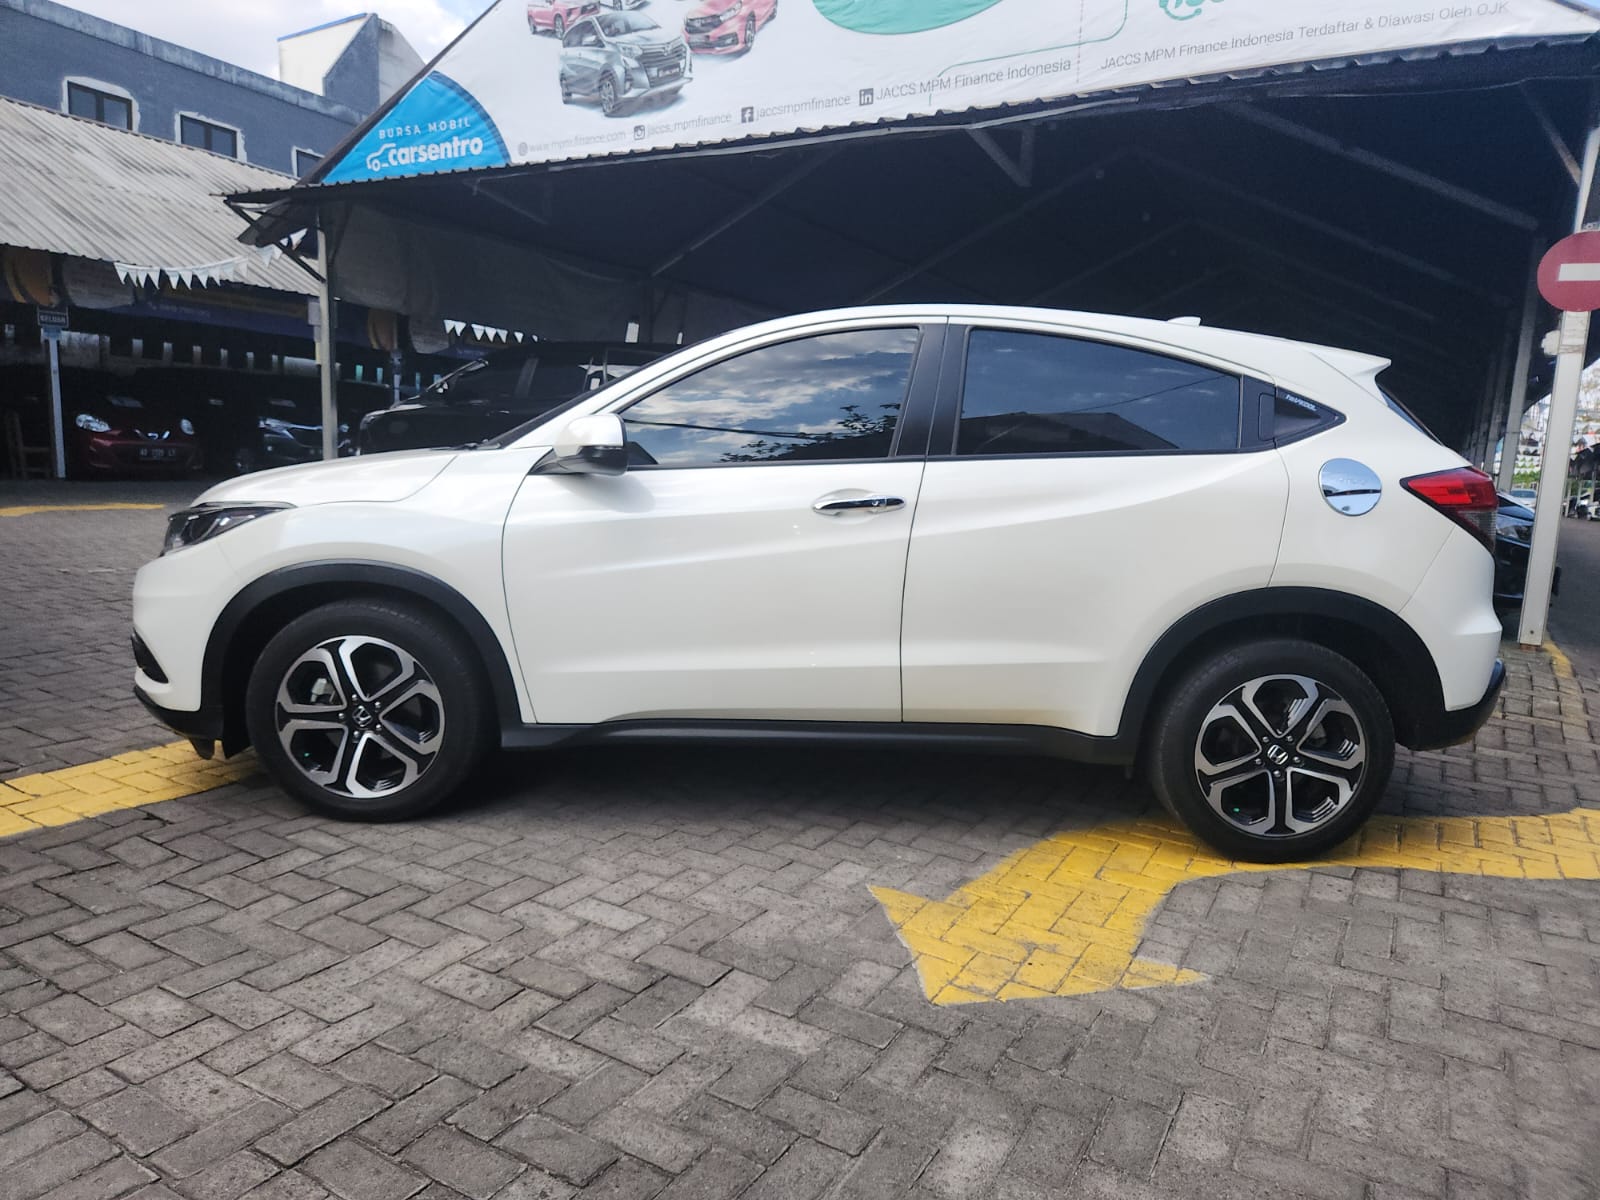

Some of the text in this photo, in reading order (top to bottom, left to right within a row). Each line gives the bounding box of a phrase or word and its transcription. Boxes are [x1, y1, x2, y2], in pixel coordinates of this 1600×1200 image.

[1100, 0, 1510, 70] JACCS MPM Finance Indonesia Terdaftar & Diawasi Oleh OJK
[876, 58, 1071, 100] JACCS MPM Finance Indonesia
[379, 117, 471, 139] BURSA MOBIL
